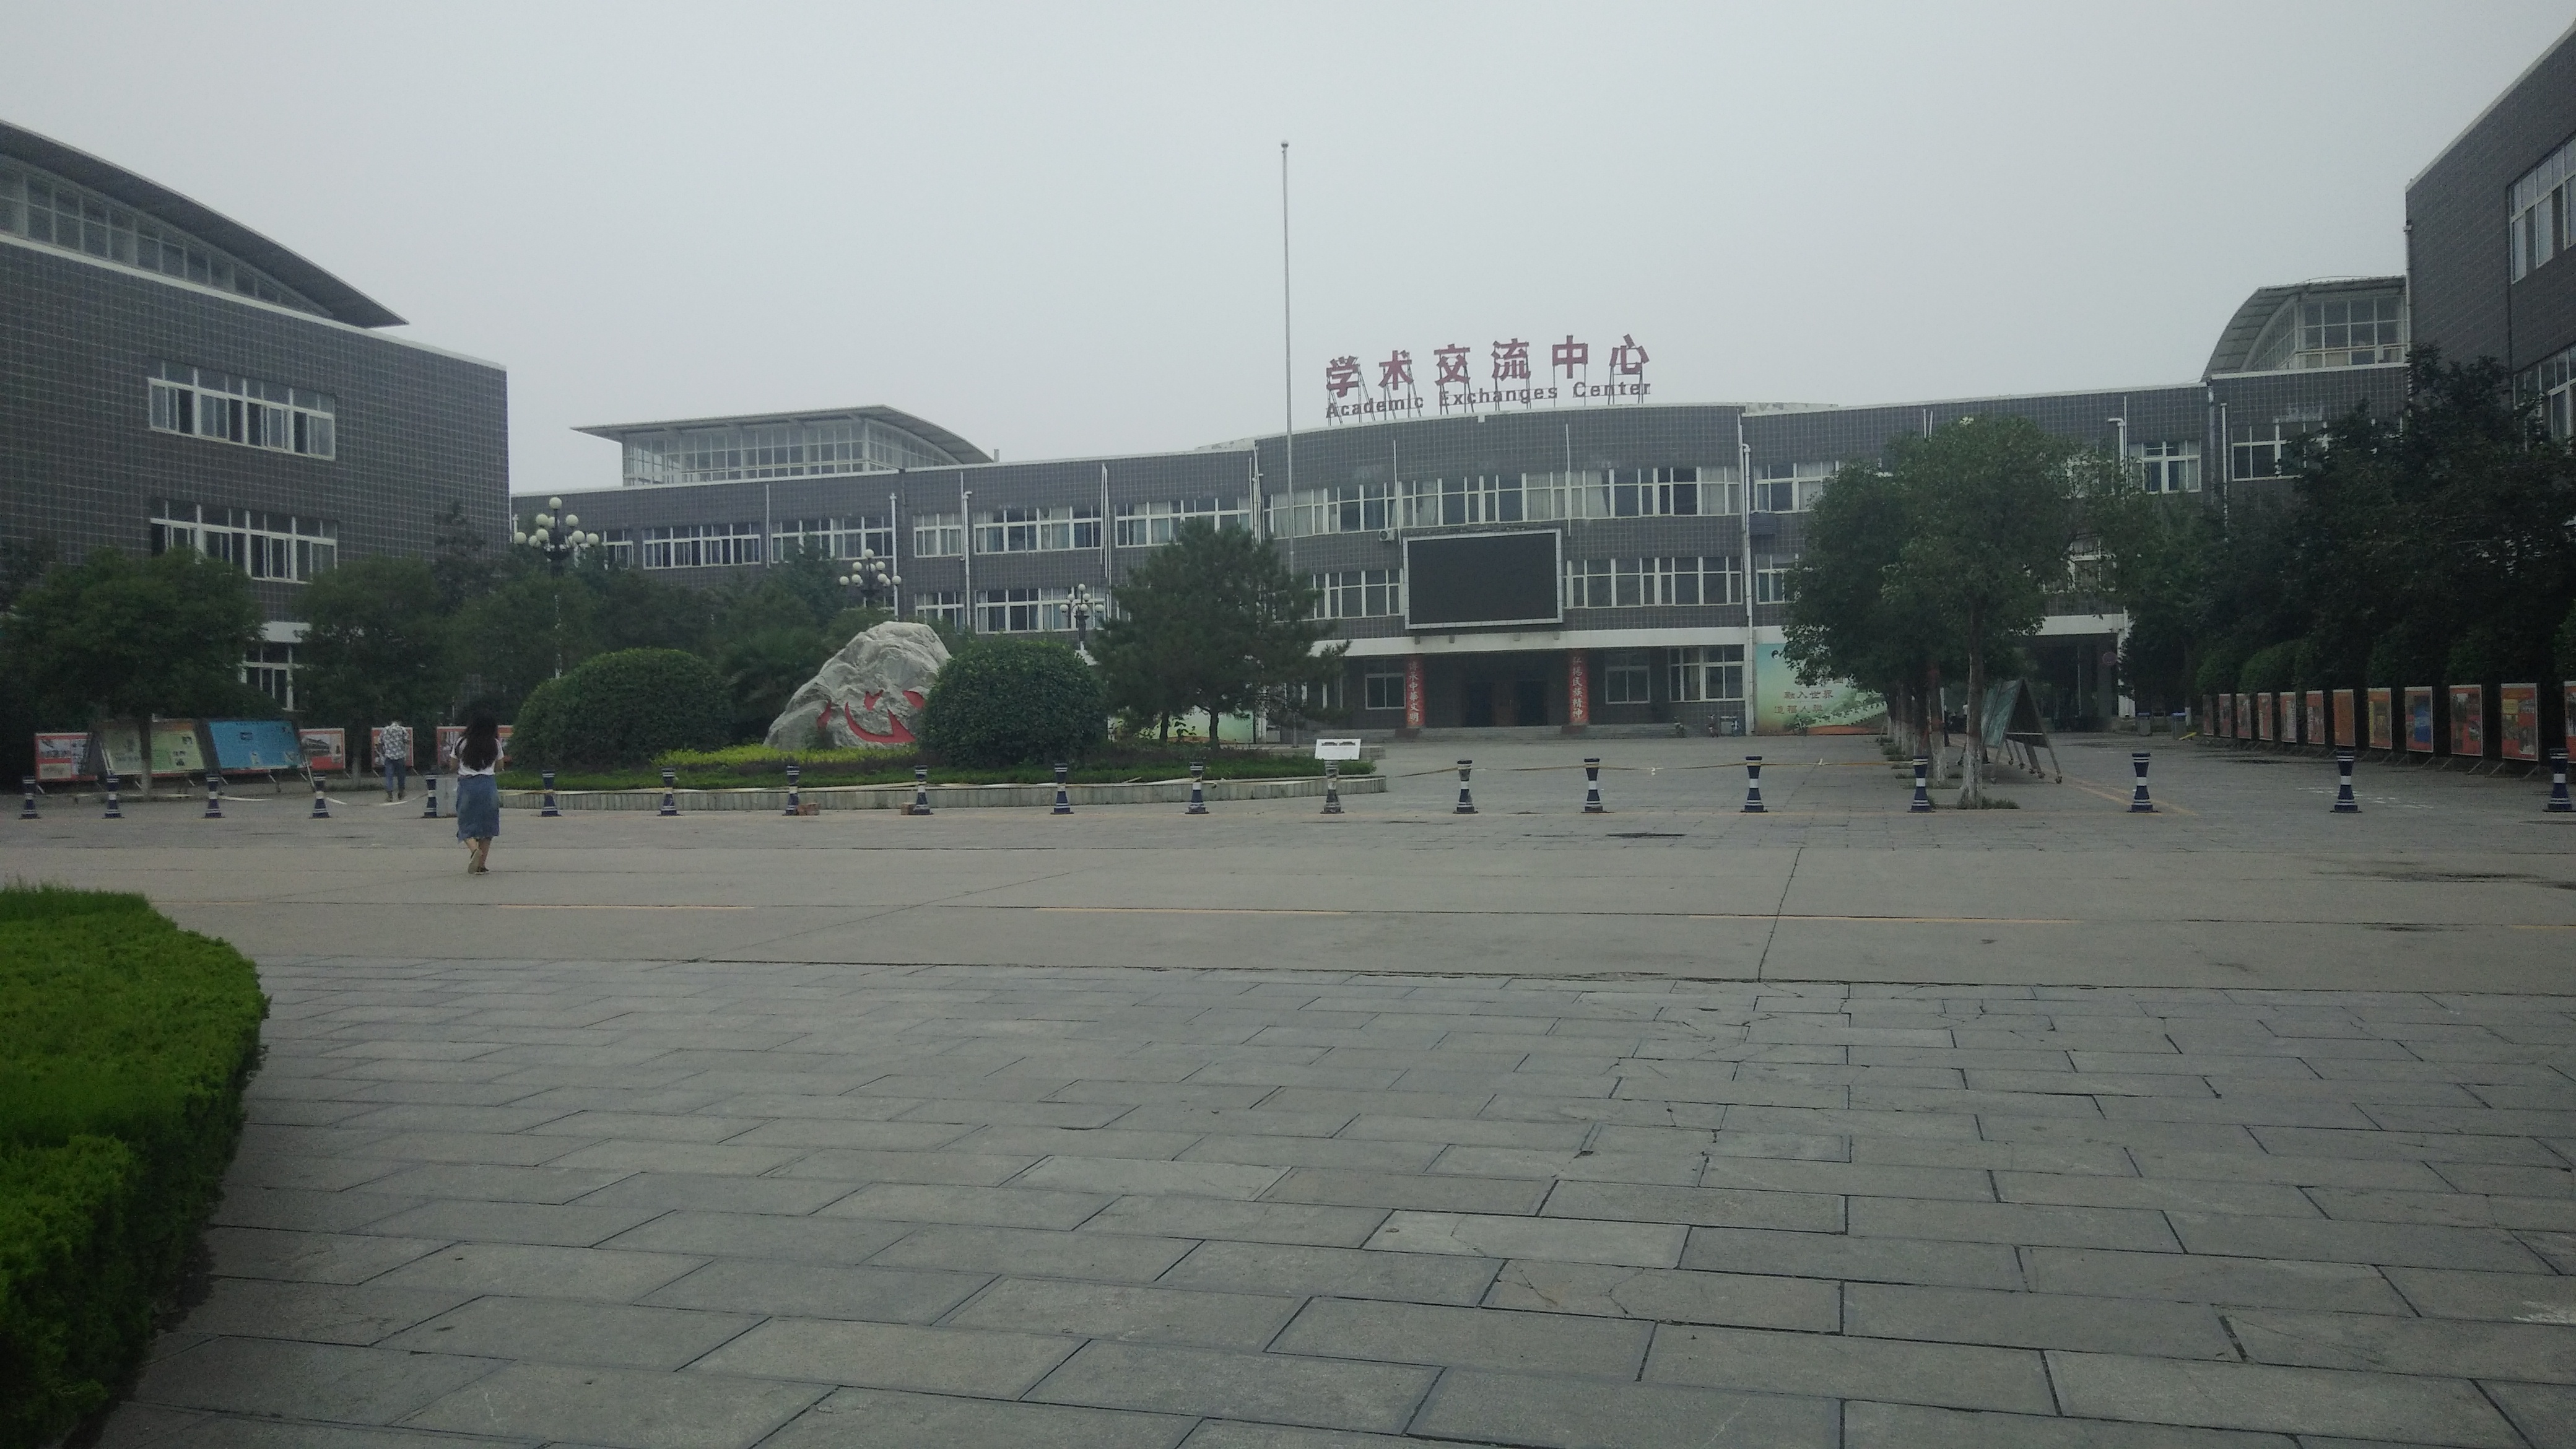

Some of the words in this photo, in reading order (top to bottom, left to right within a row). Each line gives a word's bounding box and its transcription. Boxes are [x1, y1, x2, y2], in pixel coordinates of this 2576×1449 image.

[1326, 334, 1650, 398] 学术交流中心
[1326, 397, 1424, 419] Academic
[1440, 388, 1558, 406] Exchanges
[1573, 381, 1651, 398] Center
